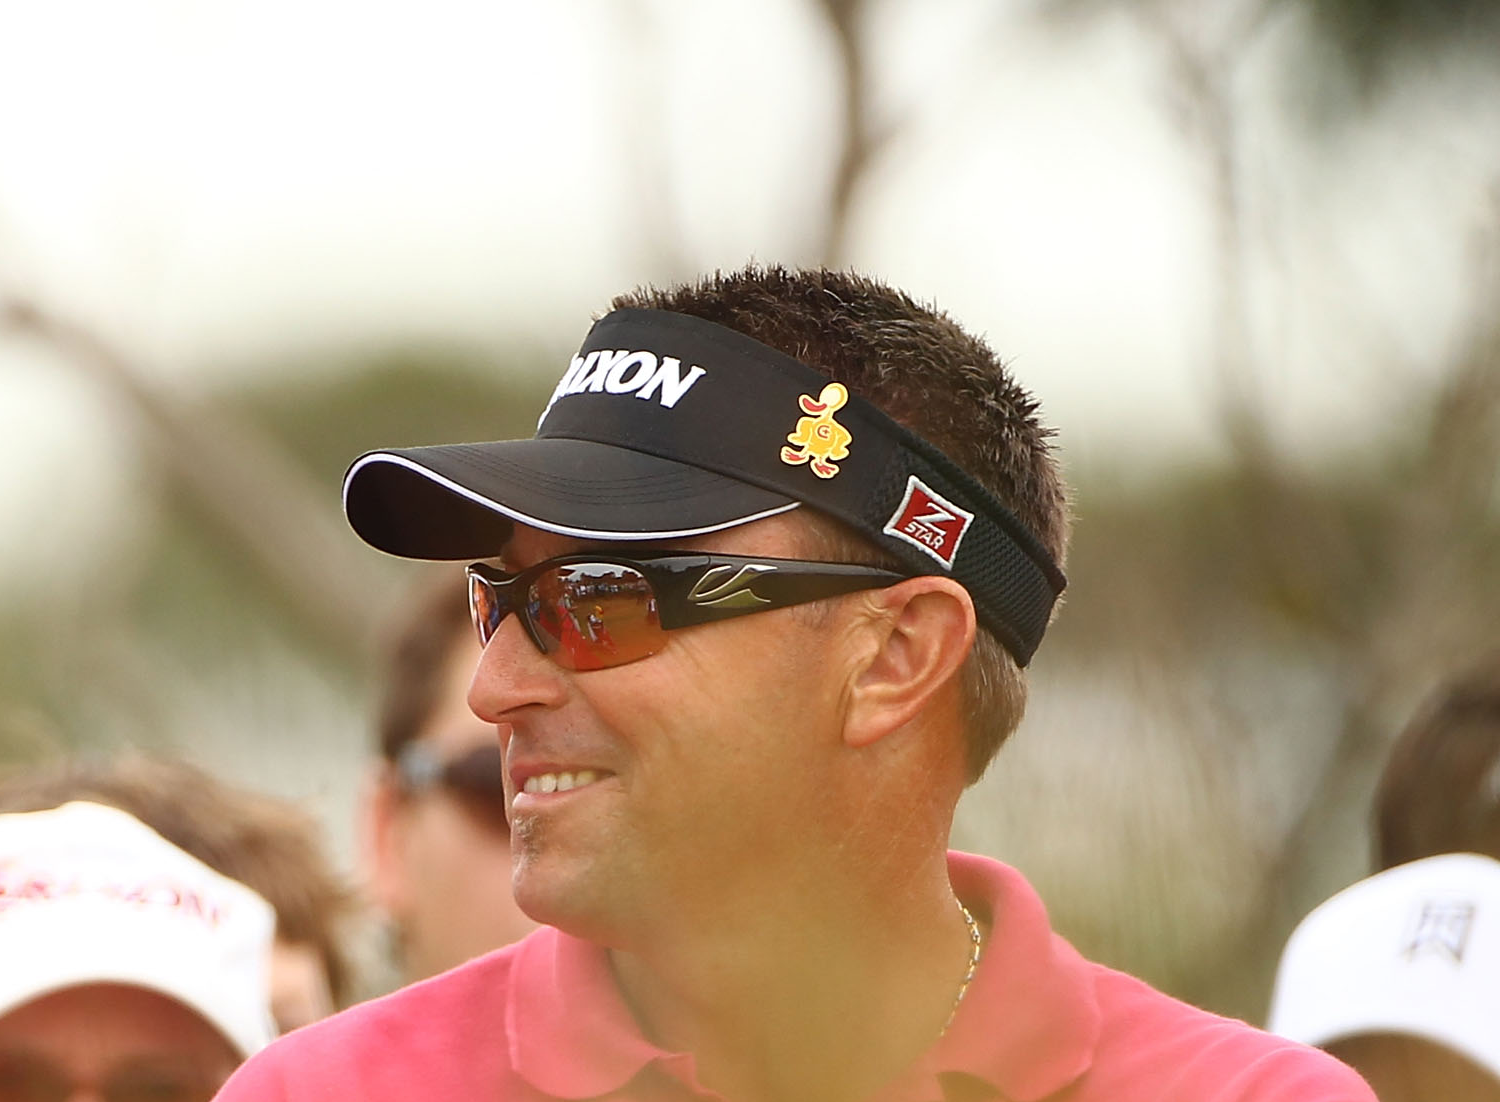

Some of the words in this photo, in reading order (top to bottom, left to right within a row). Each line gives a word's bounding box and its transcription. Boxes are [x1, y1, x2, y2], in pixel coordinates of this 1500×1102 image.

[537, 350, 706, 418] IXON
[904, 521, 945, 549] STAR
[913, 502, 956, 536] Z
